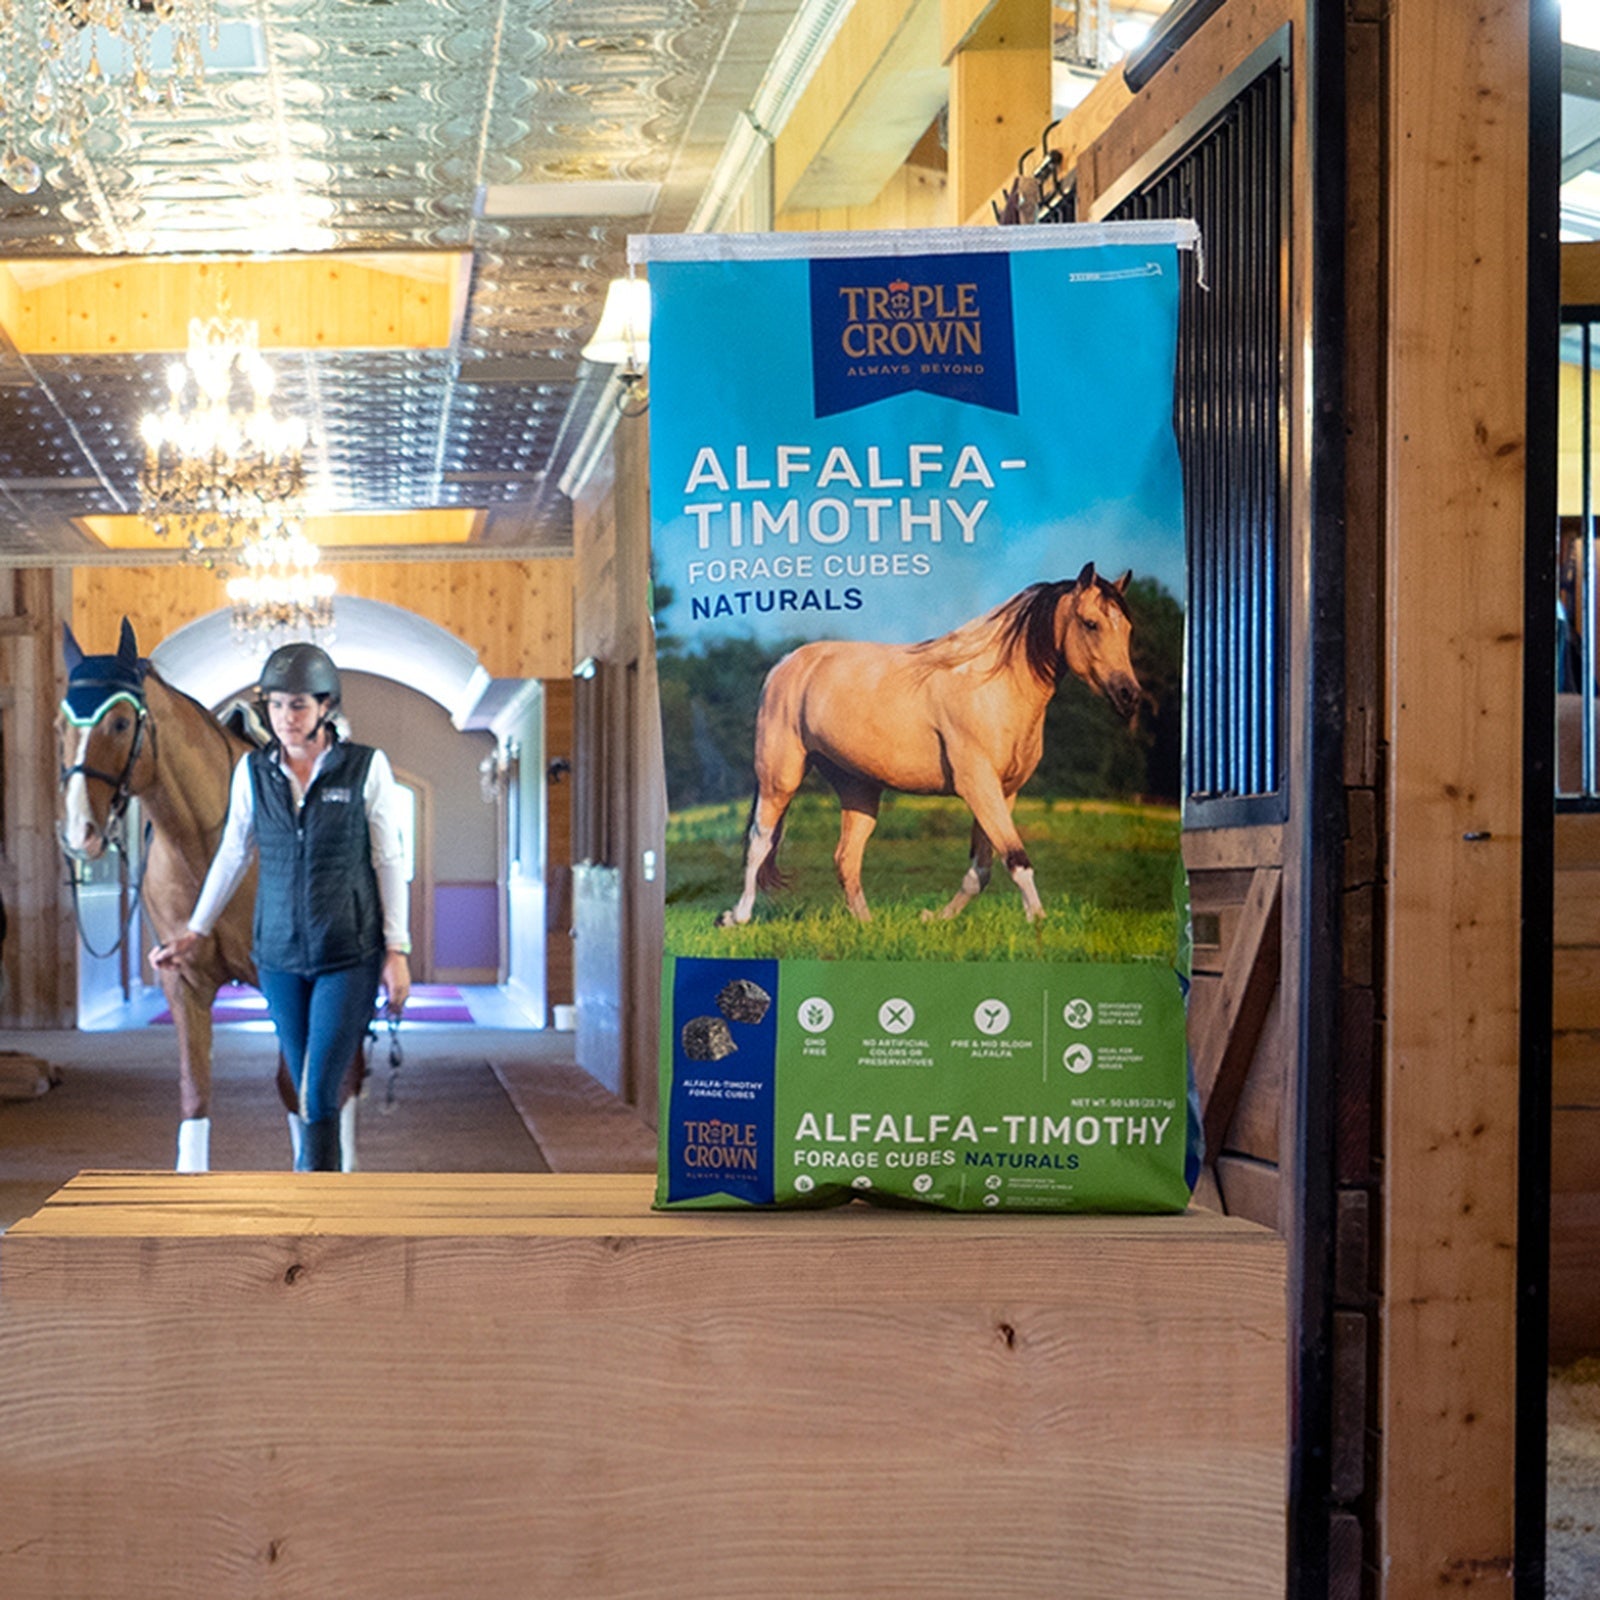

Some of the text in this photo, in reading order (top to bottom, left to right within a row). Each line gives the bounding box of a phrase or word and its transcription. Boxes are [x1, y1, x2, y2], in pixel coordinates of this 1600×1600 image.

[841, 321, 982, 358] CROWN
[847, 363, 984, 376] ALWAYS BEYOND
[683, 444, 1027, 493] ALFALFA-
[683, 498, 989, 550] TIMOTHY
[688, 553, 931, 584] FORAGE CUBES
[691, 587, 863, 620] NATURALS
[862, 1038, 930, 1048] NO ARTIFICIAL
[951, 1039, 969, 1048] PRE
[802, 1047, 827, 1056] FREE
[869, 1048, 907, 1057] COLORS
[971, 1049, 1013, 1058] ALFALFA
[858, 1057, 934, 1067] PRESERVATIVES
[682, 1079, 763, 1090] ALFALFA-TIMOTHY
[688, 1088, 756, 1100] FORAGE CUBES
[1070, 1097, 1090, 1107] NET
[794, 1112, 1171, 1146] ALFALFA-TIMOTHY
[683, 1144, 758, 1169] CROWN
[794, 1149, 1080, 1170] FORAGE CUBES NATURALS
